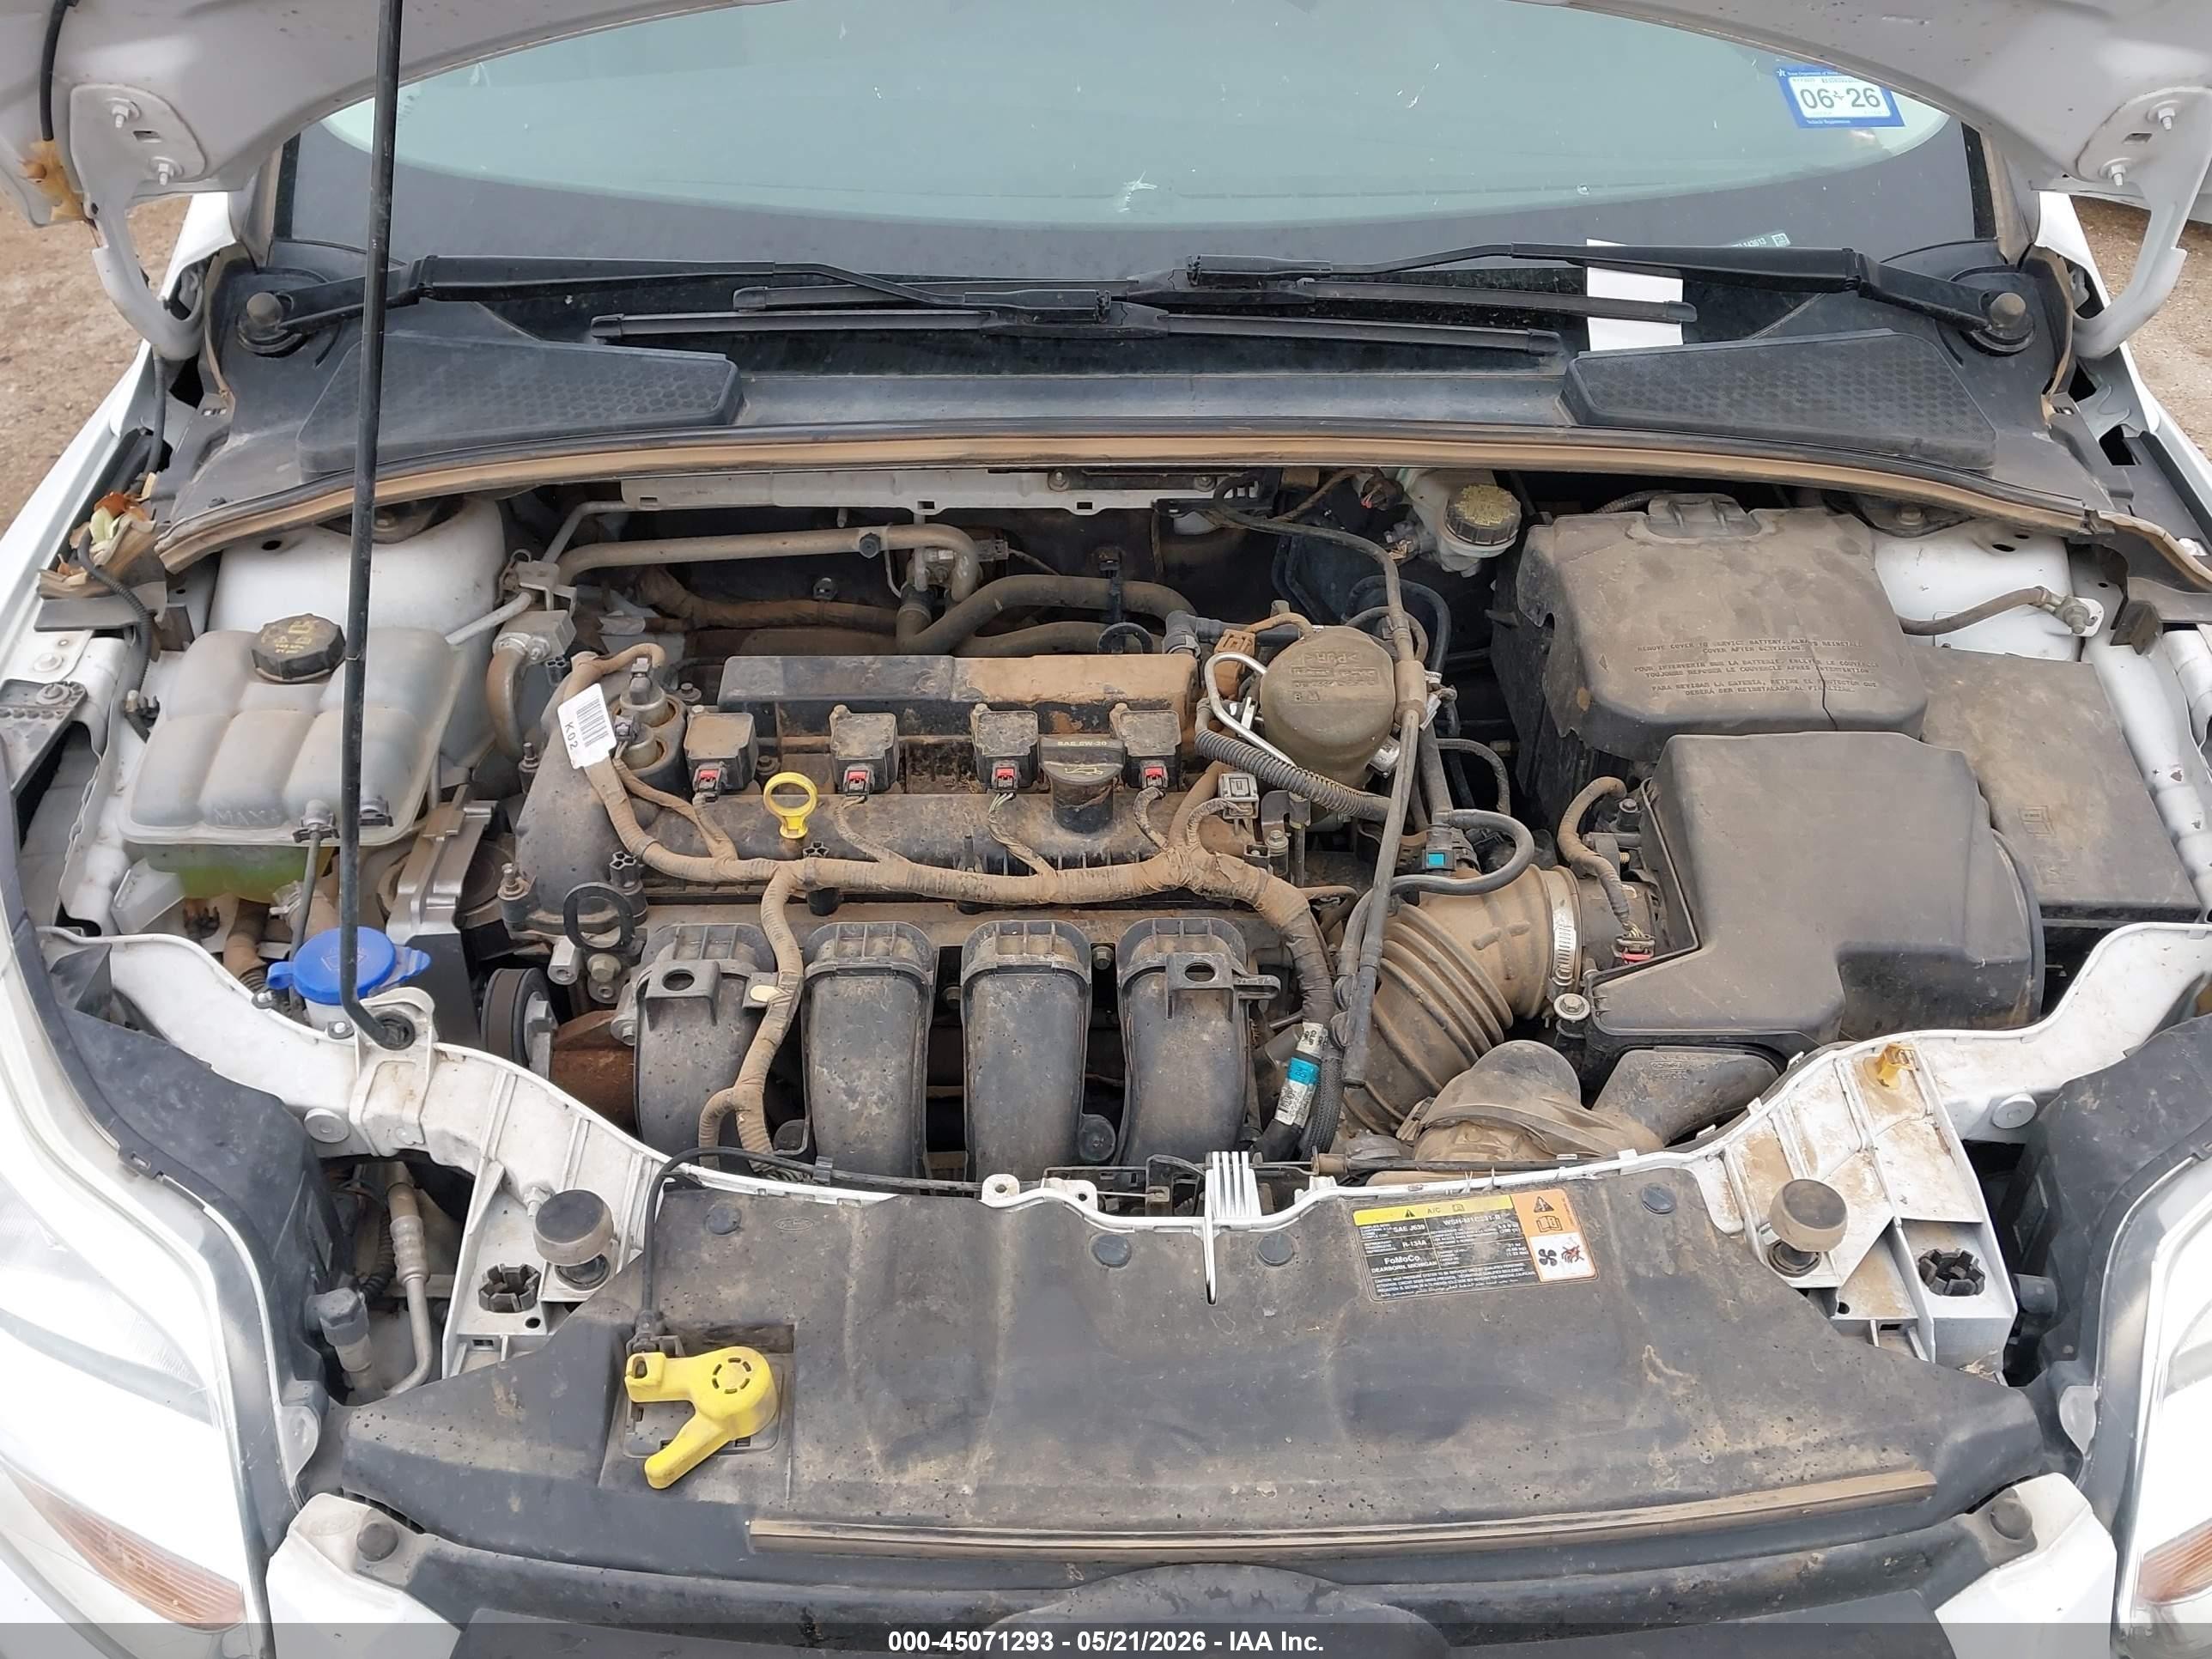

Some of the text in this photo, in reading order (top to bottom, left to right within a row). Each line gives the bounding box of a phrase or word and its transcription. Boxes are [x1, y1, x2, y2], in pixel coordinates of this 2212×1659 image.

[1800, 88, 1881, 108] 06 26
[1402, 1239, 1427, 1249] R-134A
[1383, 1255, 1420, 1265] FoMoCo
